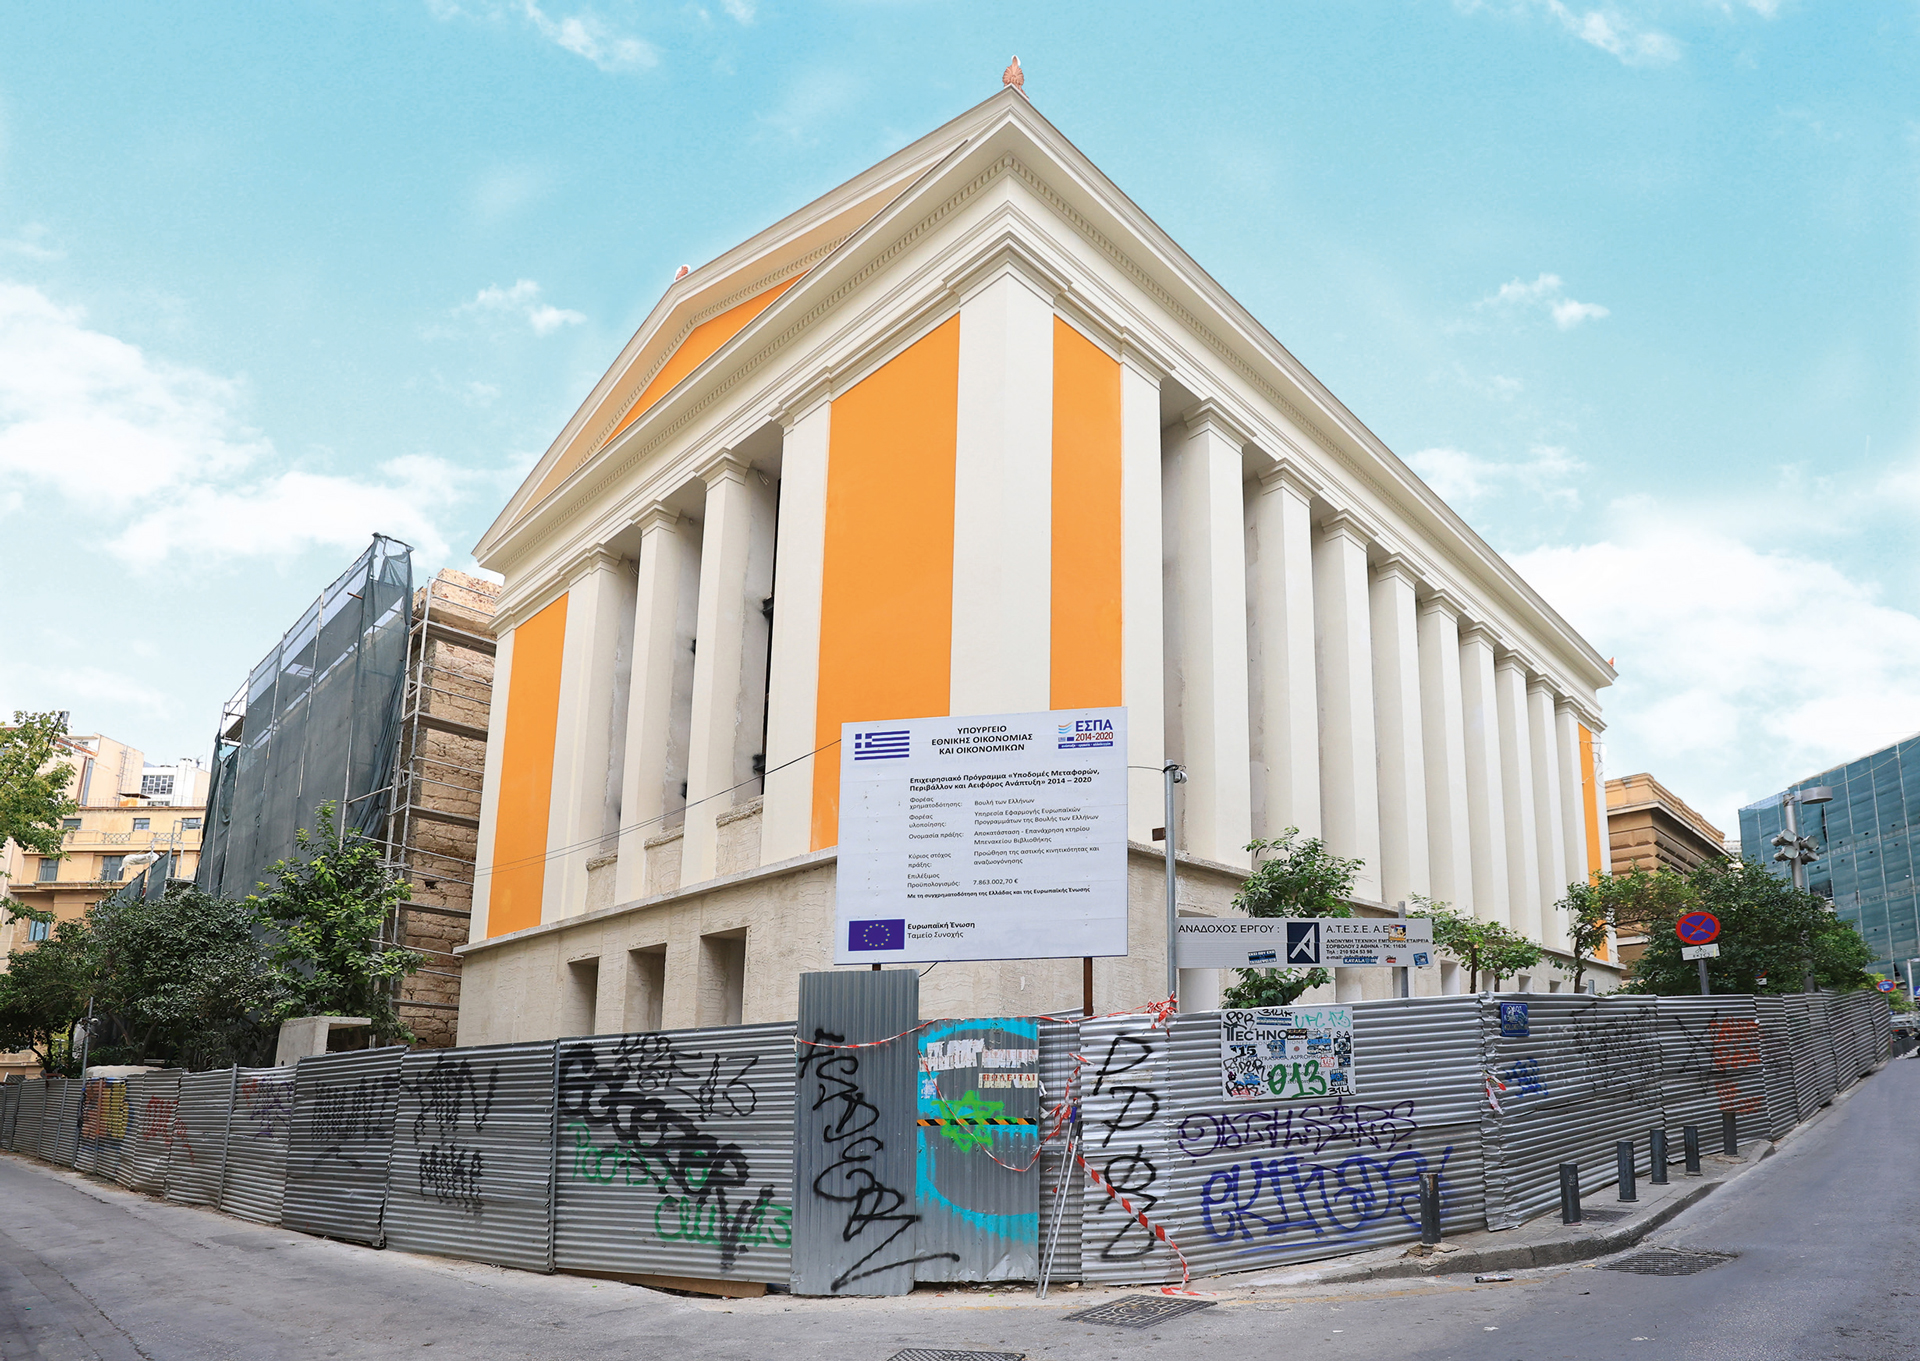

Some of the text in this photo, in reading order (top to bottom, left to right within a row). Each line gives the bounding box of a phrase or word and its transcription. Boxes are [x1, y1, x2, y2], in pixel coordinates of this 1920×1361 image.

[957, 725, 1007, 735] ΥΠΟΥΡΓΕΙΟ
[1075, 719, 1113, 732] ΕΣΠΑ
[931, 733, 1033, 746] ΕΘΝΙΚΗΣ ΟΙΚΟΝΟΜΙΑΣ
[1075, 731, 1114, 742] 2014-2020
[956, 744, 1025, 754] ΟΙΚΟΝΟΜΙΚΩΝ
[909, 768, 1100, 784] Επιχειρησιακό Πρόγραμμα «Υποδομές Μεταφορών,
[909, 783, 953, 792] Περιβάλλον
[968, 781, 1004, 789] Αειφόρος
[1004, 778, 1046, 787] Ανάπτυξη»
[909, 802, 963, 811] χρηματοδότησης:
[1004, 808, 1041, 816] Εφαρμογής
[1041, 806, 1081, 814] Ευρωπαϊκών
[908, 821, 947, 829] υλοποίησης:
[973, 829, 1020, 837] Αποκατάσταση
[1025, 827, 1065, 835] Επανάχρηση
[973, 849, 1008, 857] Προώθηση
[973, 858, 1023, 866] αναζωογόνησης
[907, 881, 961, 889] Προϋπολογισμός:
[924, 891, 978, 899] συγχρηματοδότηση
[907, 922, 949, 930] Ευρωπαϊκή
[1178, 924, 1237, 933] ΑΝΑΔΟΧΟΣ
[1240, 924, 1275, 933] ΕΡΓΟΥ
[1326, 925, 1371, 934] Α.Τ.Ε.Σ.Ε.
[933, 930, 964, 939] Συνοχής
